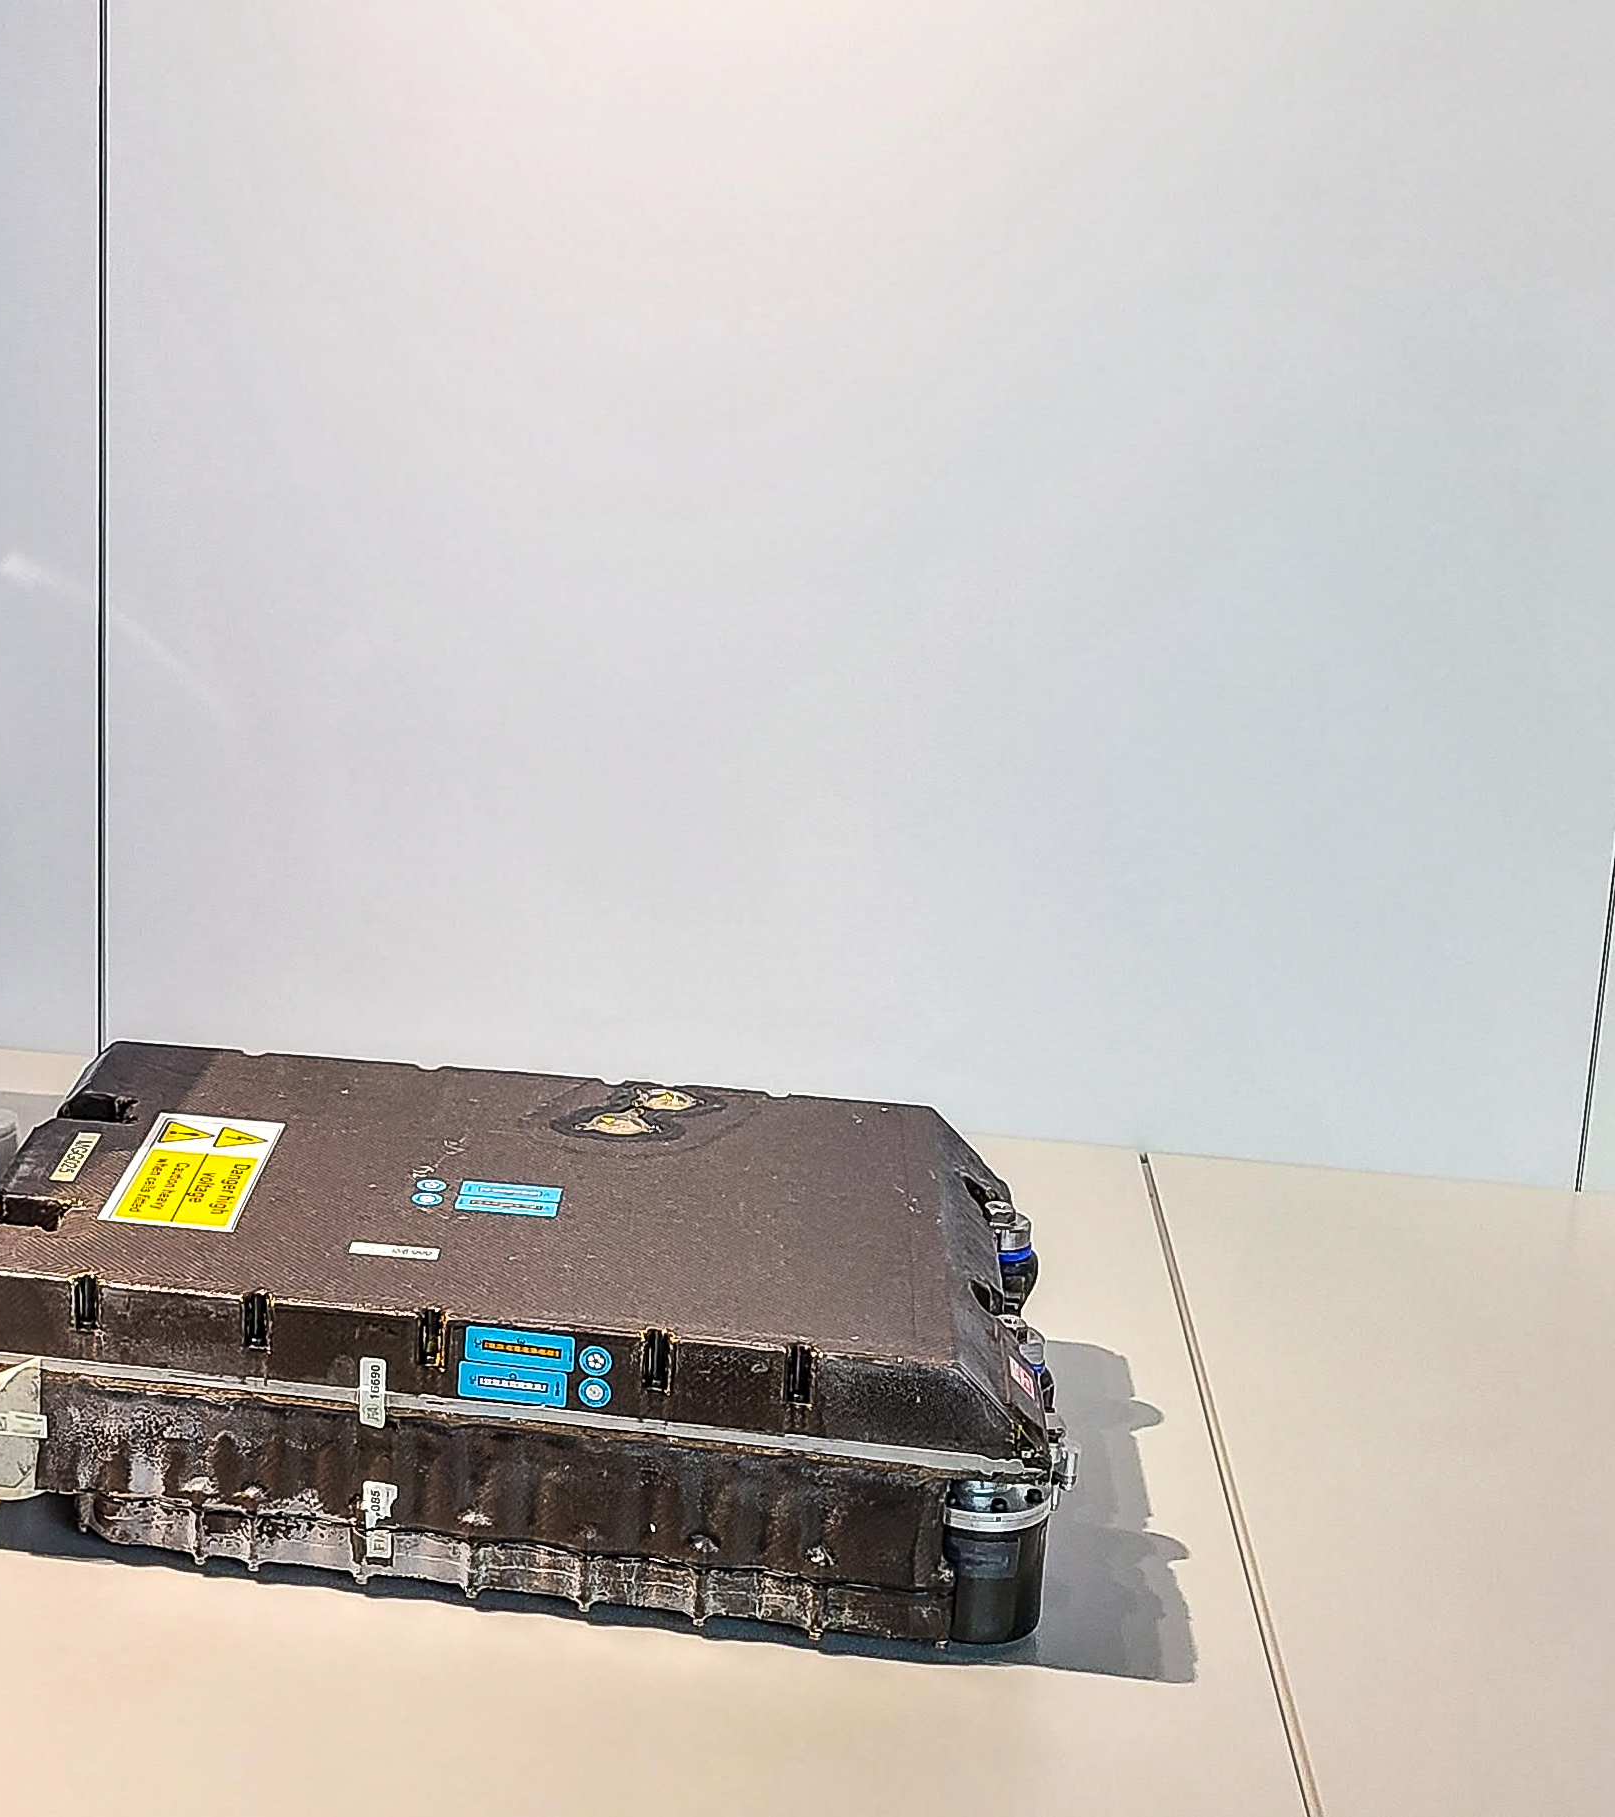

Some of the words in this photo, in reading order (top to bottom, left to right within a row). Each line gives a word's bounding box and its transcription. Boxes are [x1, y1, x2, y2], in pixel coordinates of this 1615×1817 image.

[186, 1170, 216, 1203] voltage
[221, 1163, 252, 1193] Danger
[209, 1194, 236, 1215] high
